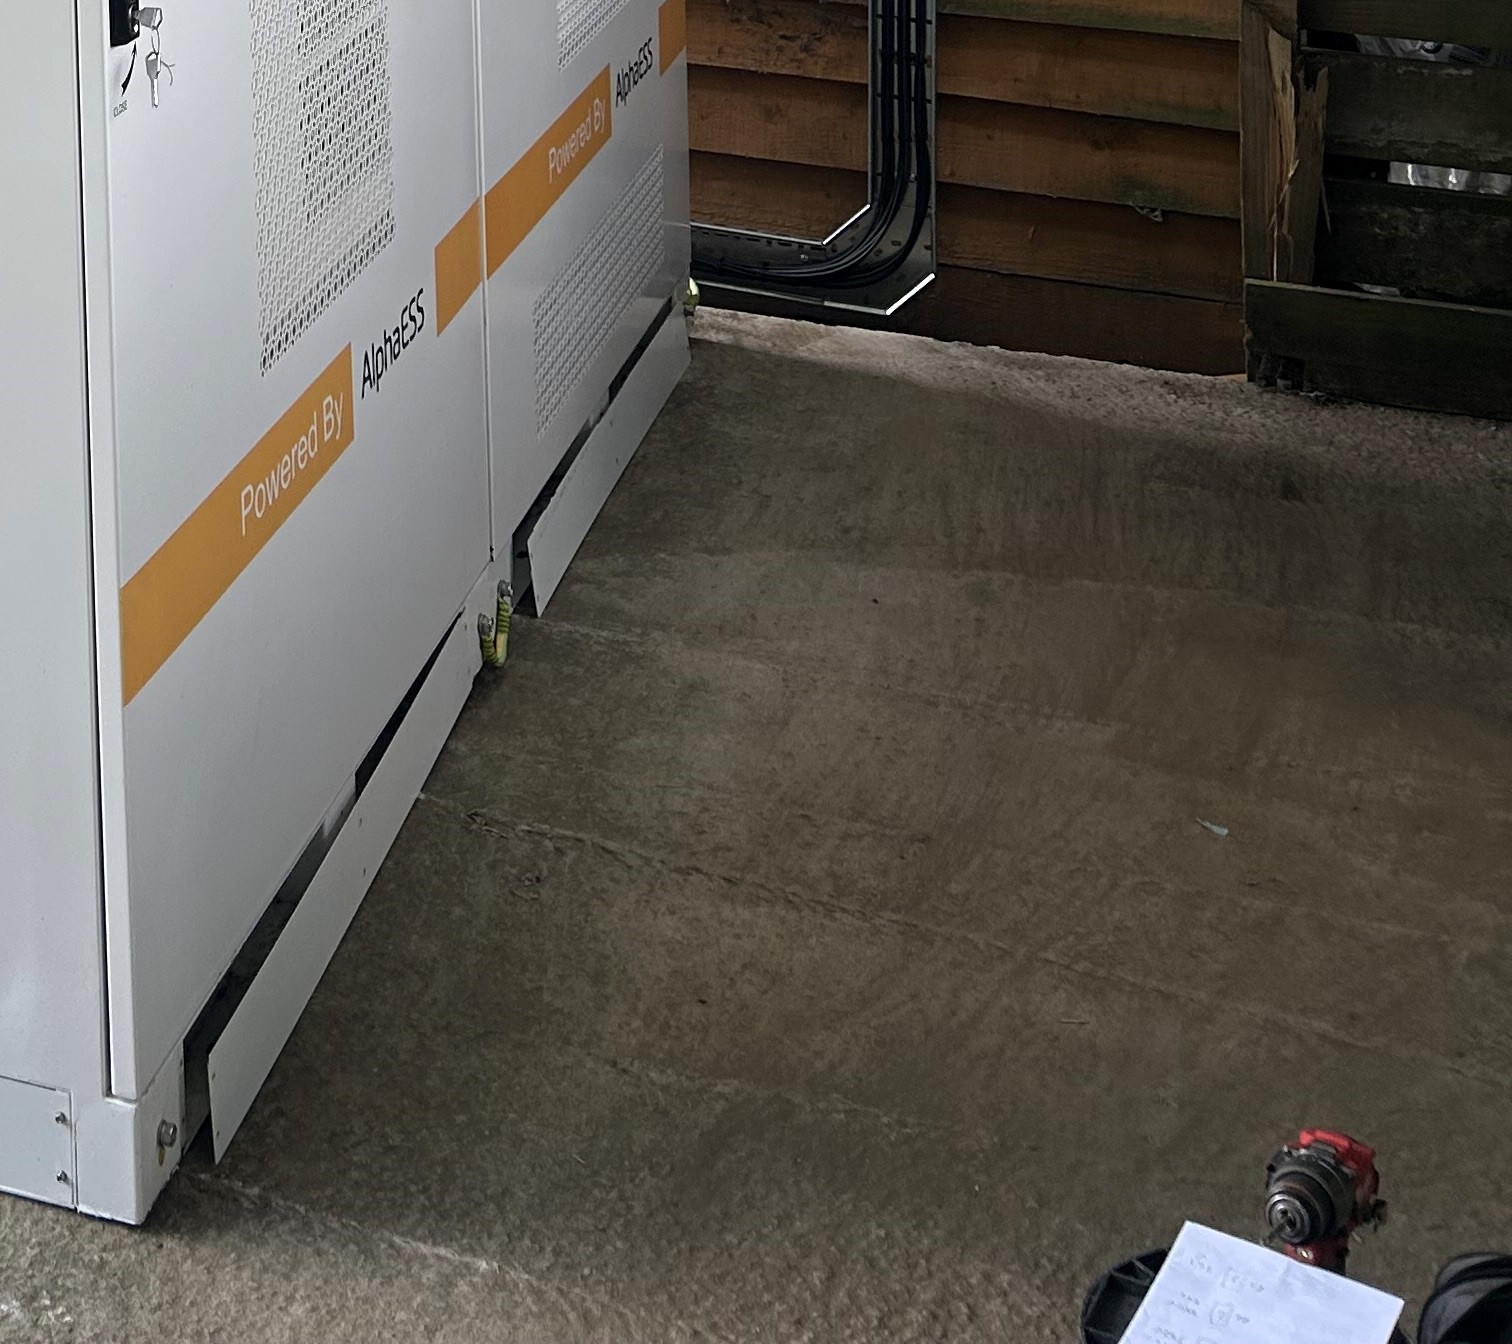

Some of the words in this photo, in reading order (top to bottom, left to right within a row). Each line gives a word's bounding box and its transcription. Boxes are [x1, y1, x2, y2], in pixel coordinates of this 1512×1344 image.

[548, 109, 592, 184] Powered
[593, 97, 606, 134] By
[615, 36, 653, 109] AlphaESS
[240, 410, 318, 538] Powered
[322, 391, 344, 443] By
[360, 287, 425, 400] AlphaESS
